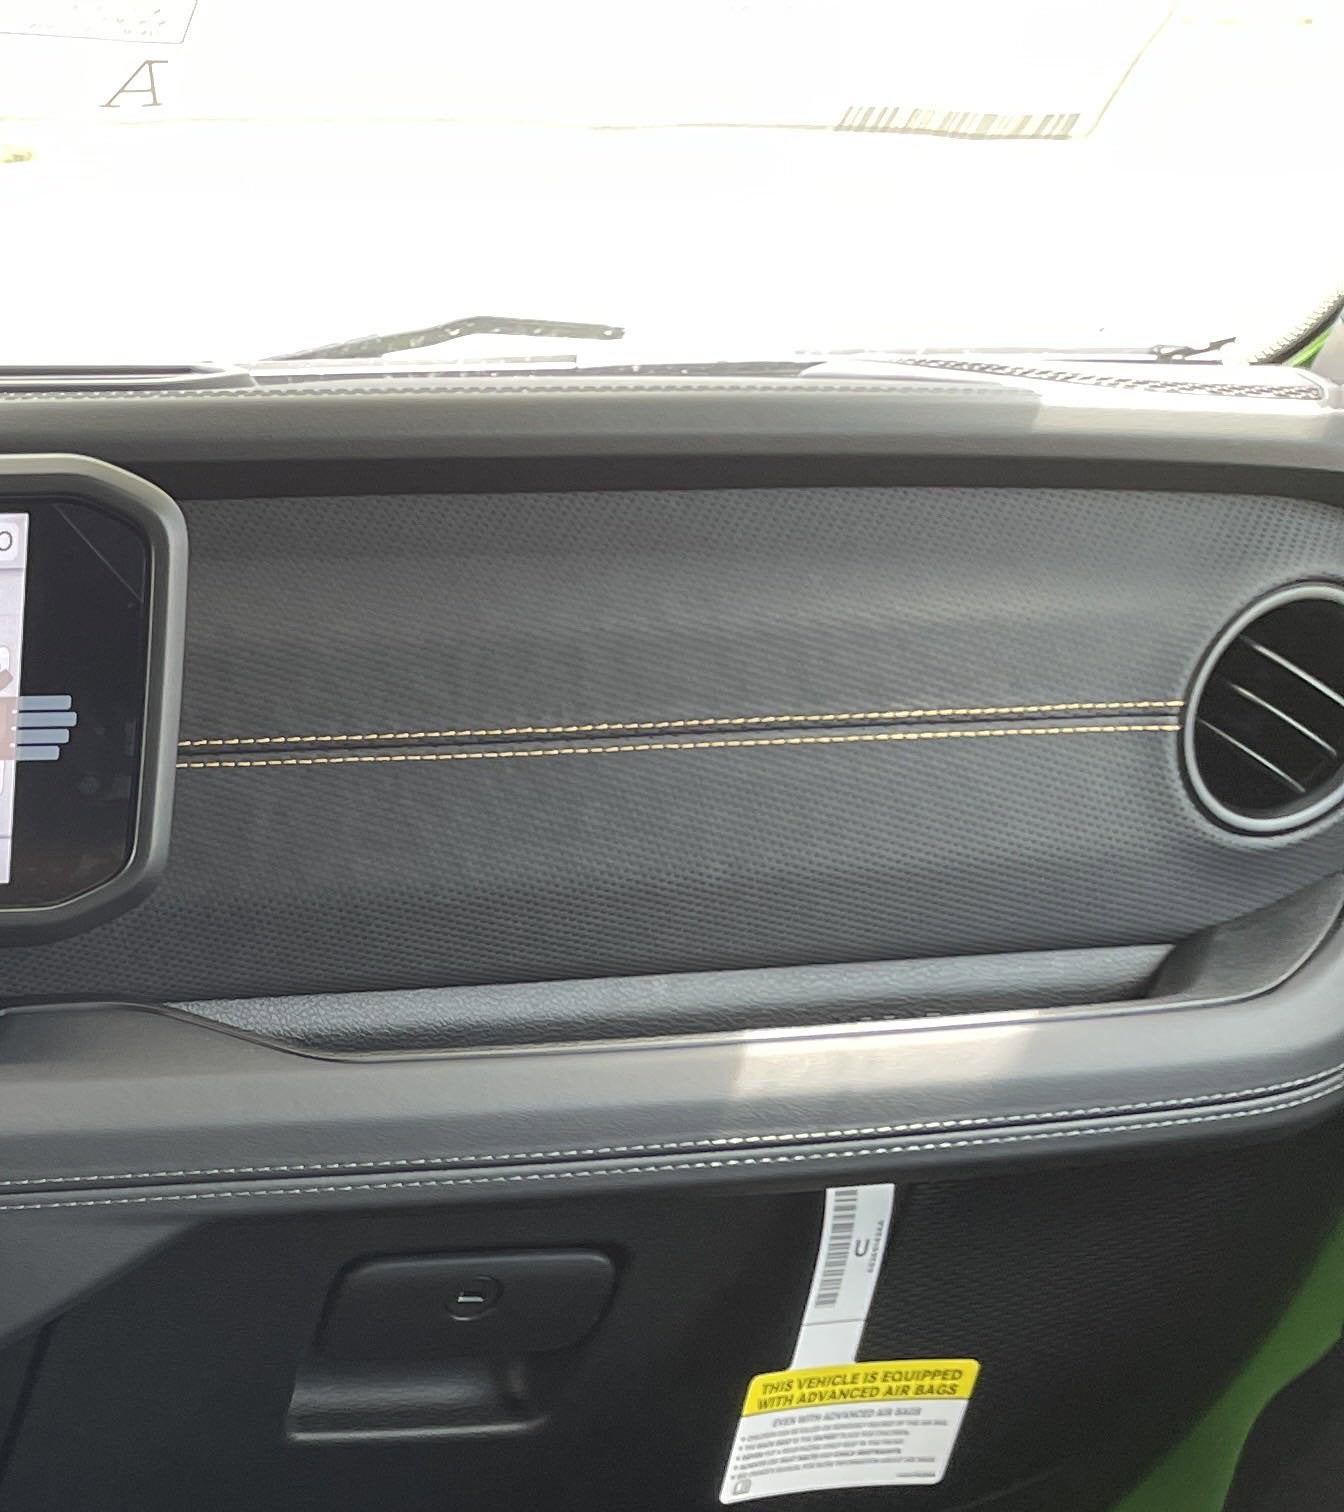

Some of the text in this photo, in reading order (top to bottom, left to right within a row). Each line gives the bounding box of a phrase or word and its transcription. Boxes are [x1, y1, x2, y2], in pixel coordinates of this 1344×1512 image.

[762, 1369, 963, 1396] THIS VEHICLE IS EQUIPPED
[757, 1383, 958, 1410] WITH ADVANCED AIR BAGS
